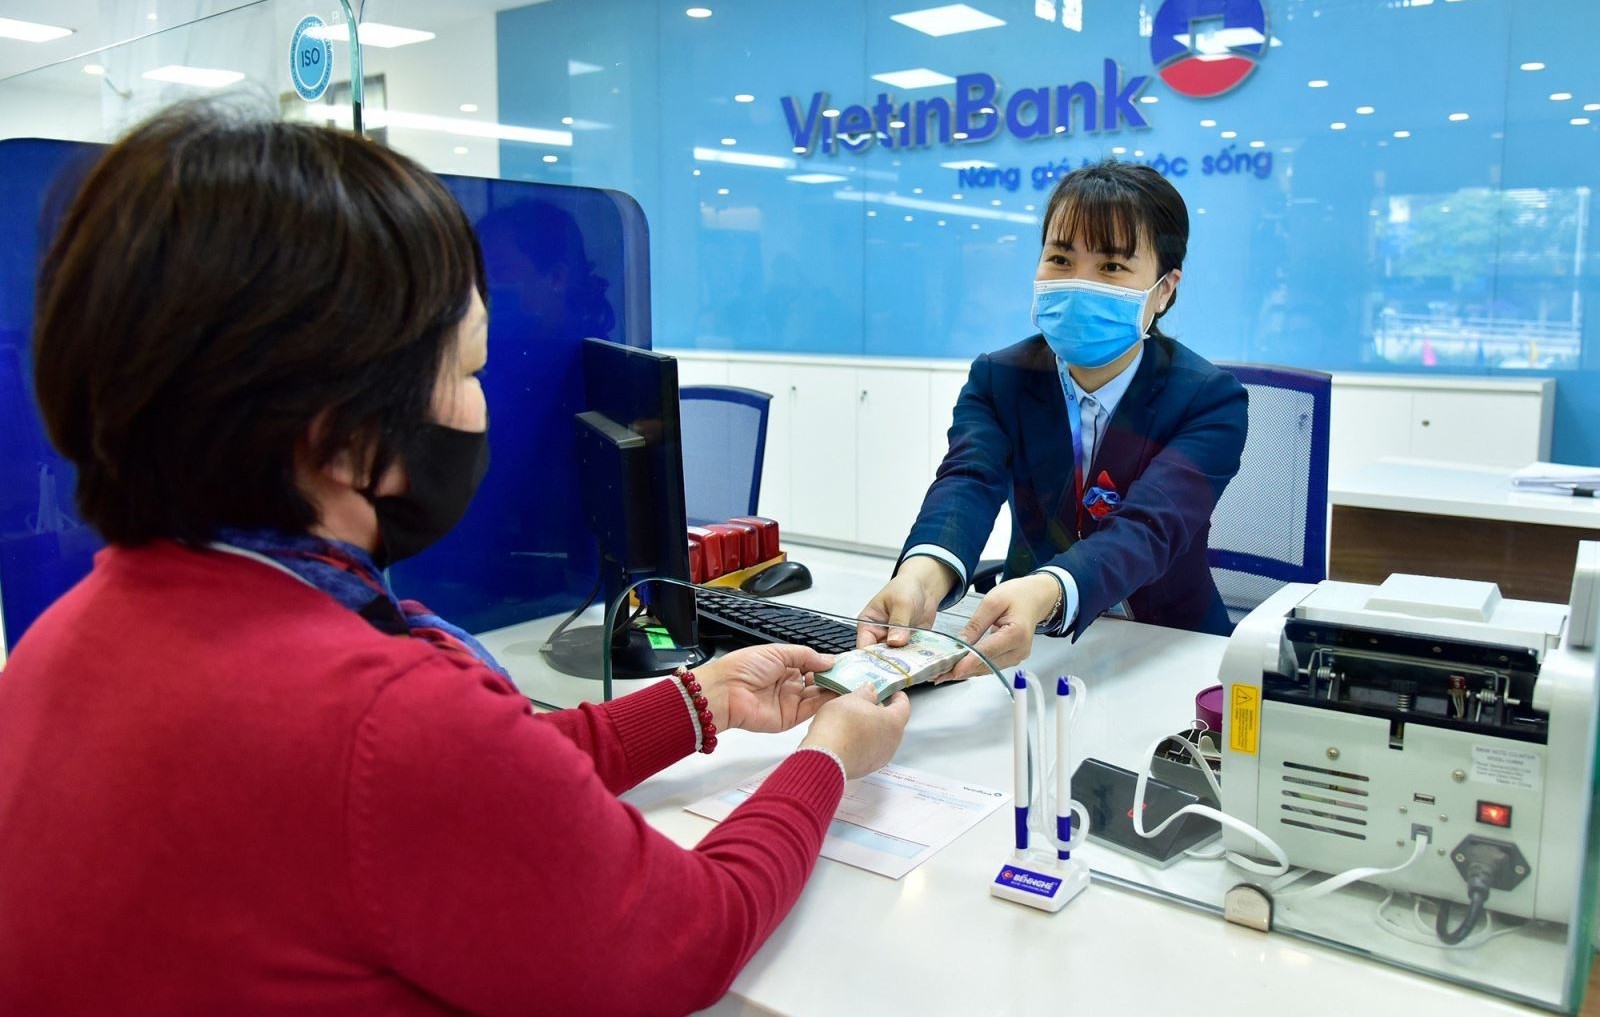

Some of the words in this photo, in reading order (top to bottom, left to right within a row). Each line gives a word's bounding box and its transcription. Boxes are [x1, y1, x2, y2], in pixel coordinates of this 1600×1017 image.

[301, 47, 320, 68] ISO
[780, 57, 1151, 156] VietinBank
[1201, 145, 1273, 180] sống
